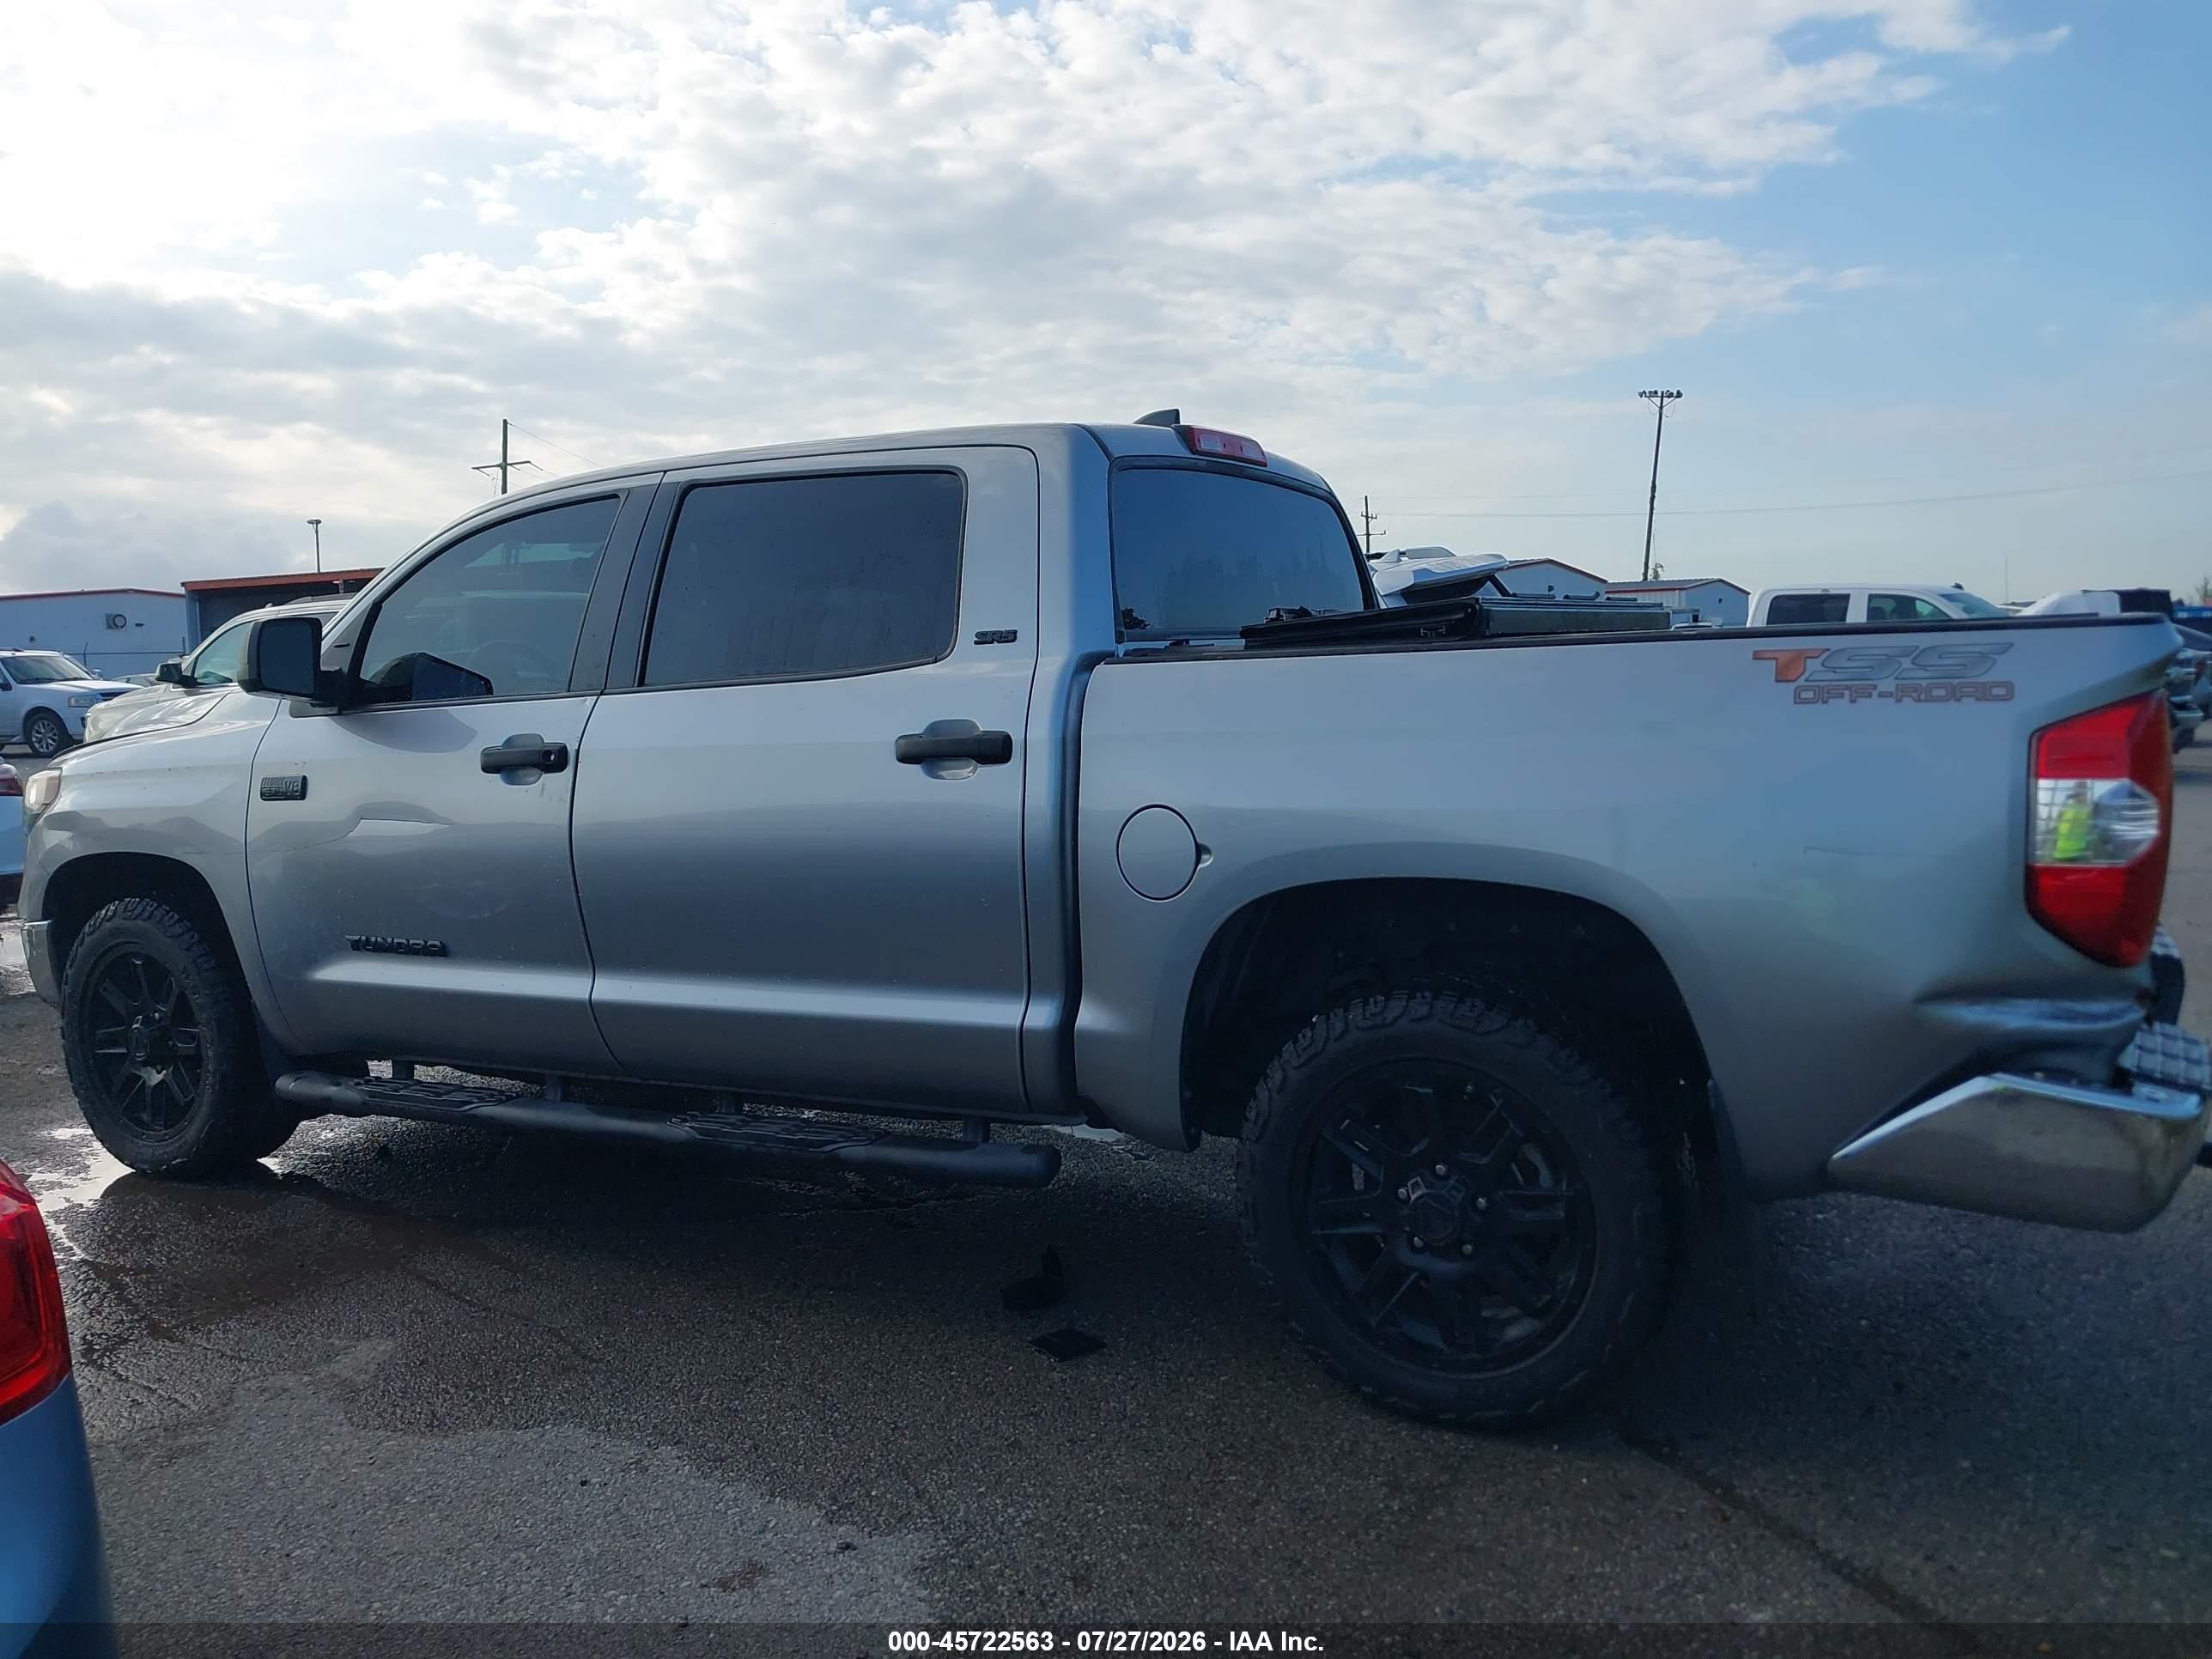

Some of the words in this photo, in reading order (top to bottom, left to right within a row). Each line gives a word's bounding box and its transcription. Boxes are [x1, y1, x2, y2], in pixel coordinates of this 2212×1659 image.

[974, 629, 1018, 645] SR5
[1753, 643, 2014, 683] TSS
[1794, 682, 2014, 704] OFF-ROAD
[344, 935, 448, 957] TUNDRA
